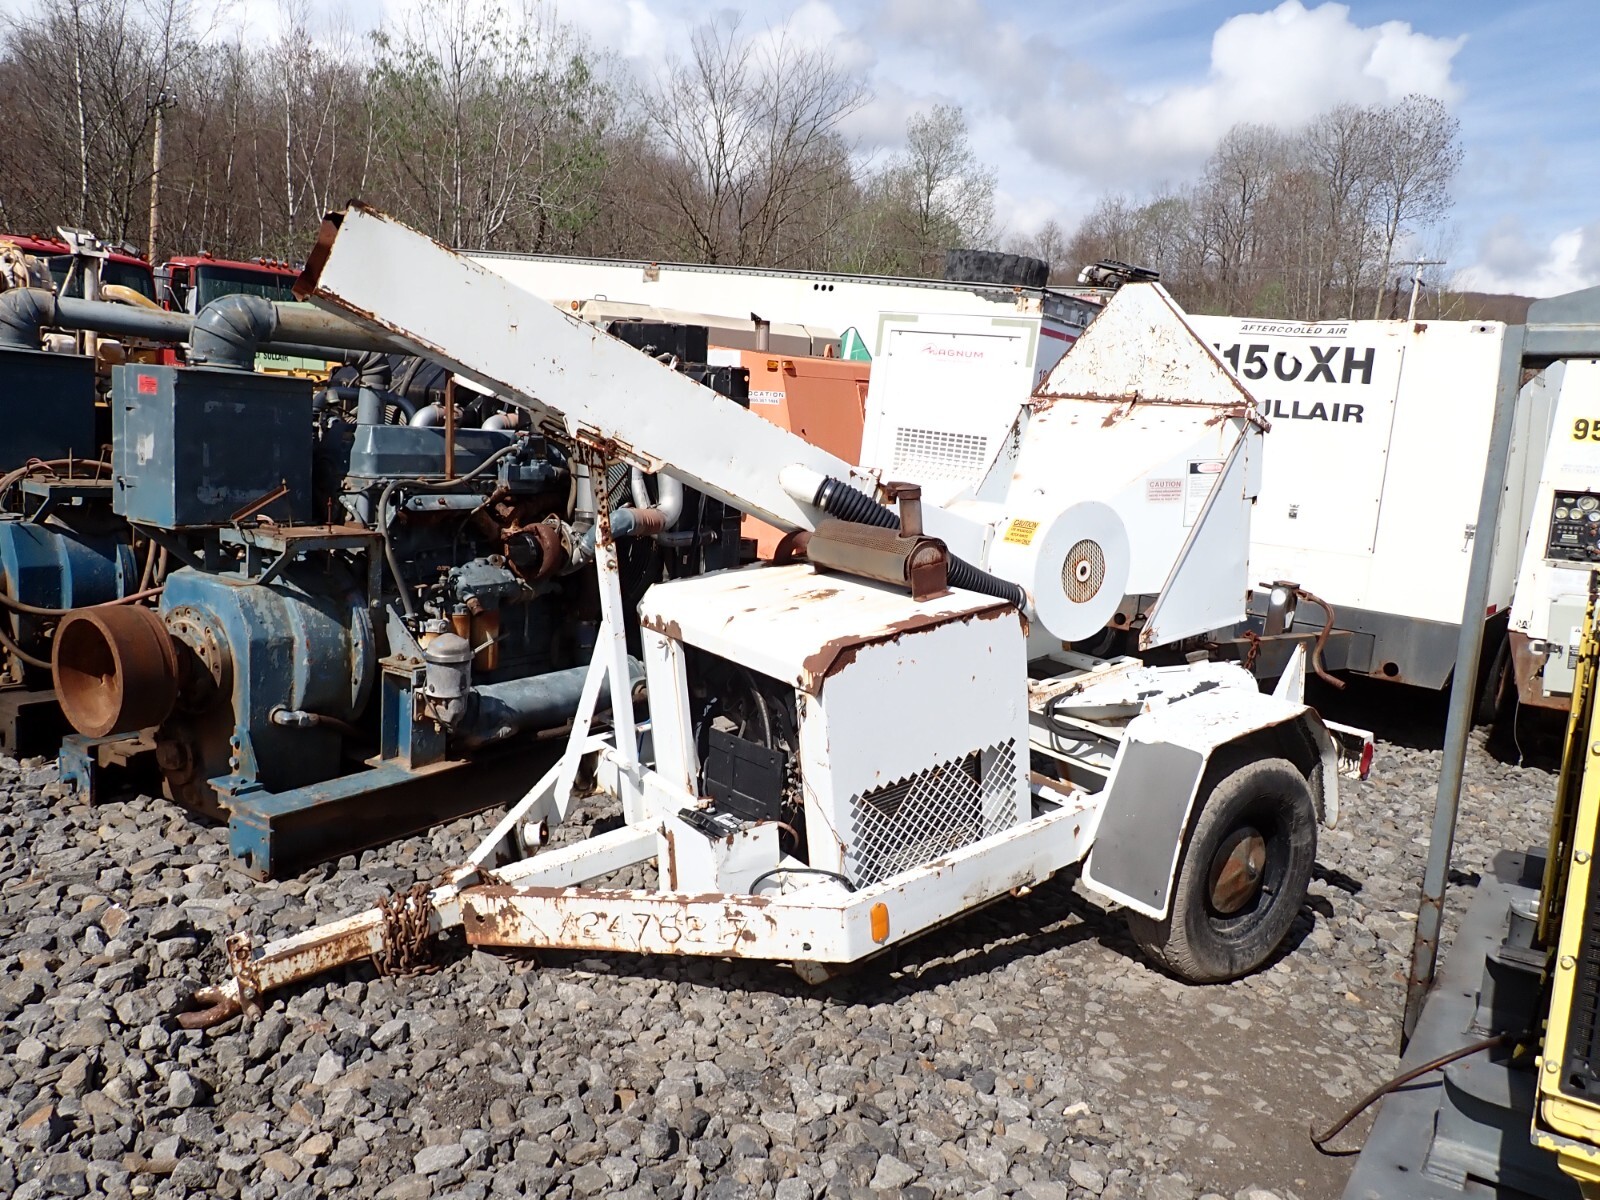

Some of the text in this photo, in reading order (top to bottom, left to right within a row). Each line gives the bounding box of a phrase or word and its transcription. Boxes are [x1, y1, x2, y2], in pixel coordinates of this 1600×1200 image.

[1241, 324, 1348, 335] AFTERCOOLED AIR
[1213, 343, 1376, 384] 150XH
[1013, 519, 1039, 529] CAUTION
